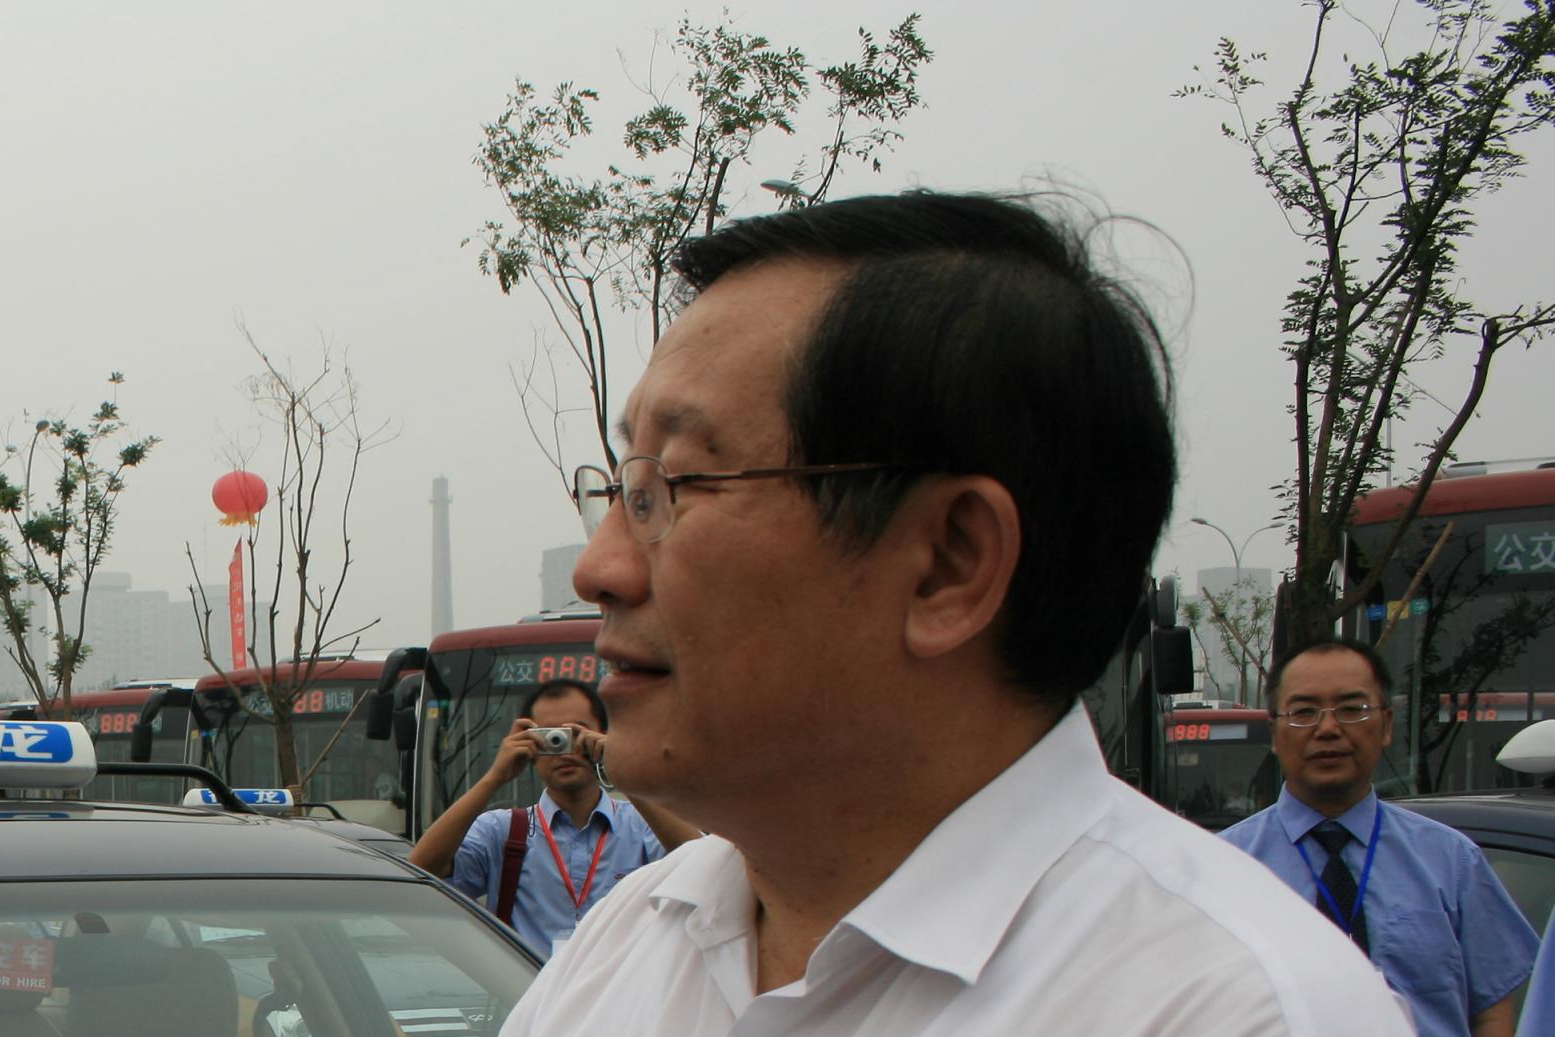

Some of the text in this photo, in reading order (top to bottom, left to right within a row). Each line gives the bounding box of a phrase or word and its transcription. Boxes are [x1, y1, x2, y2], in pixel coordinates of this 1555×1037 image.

[1493, 531, 1555, 571] 公交
[499, 659, 534, 683] 公交
[325, 690, 354, 710] 机动
[16, 976, 46, 989] HIRE
